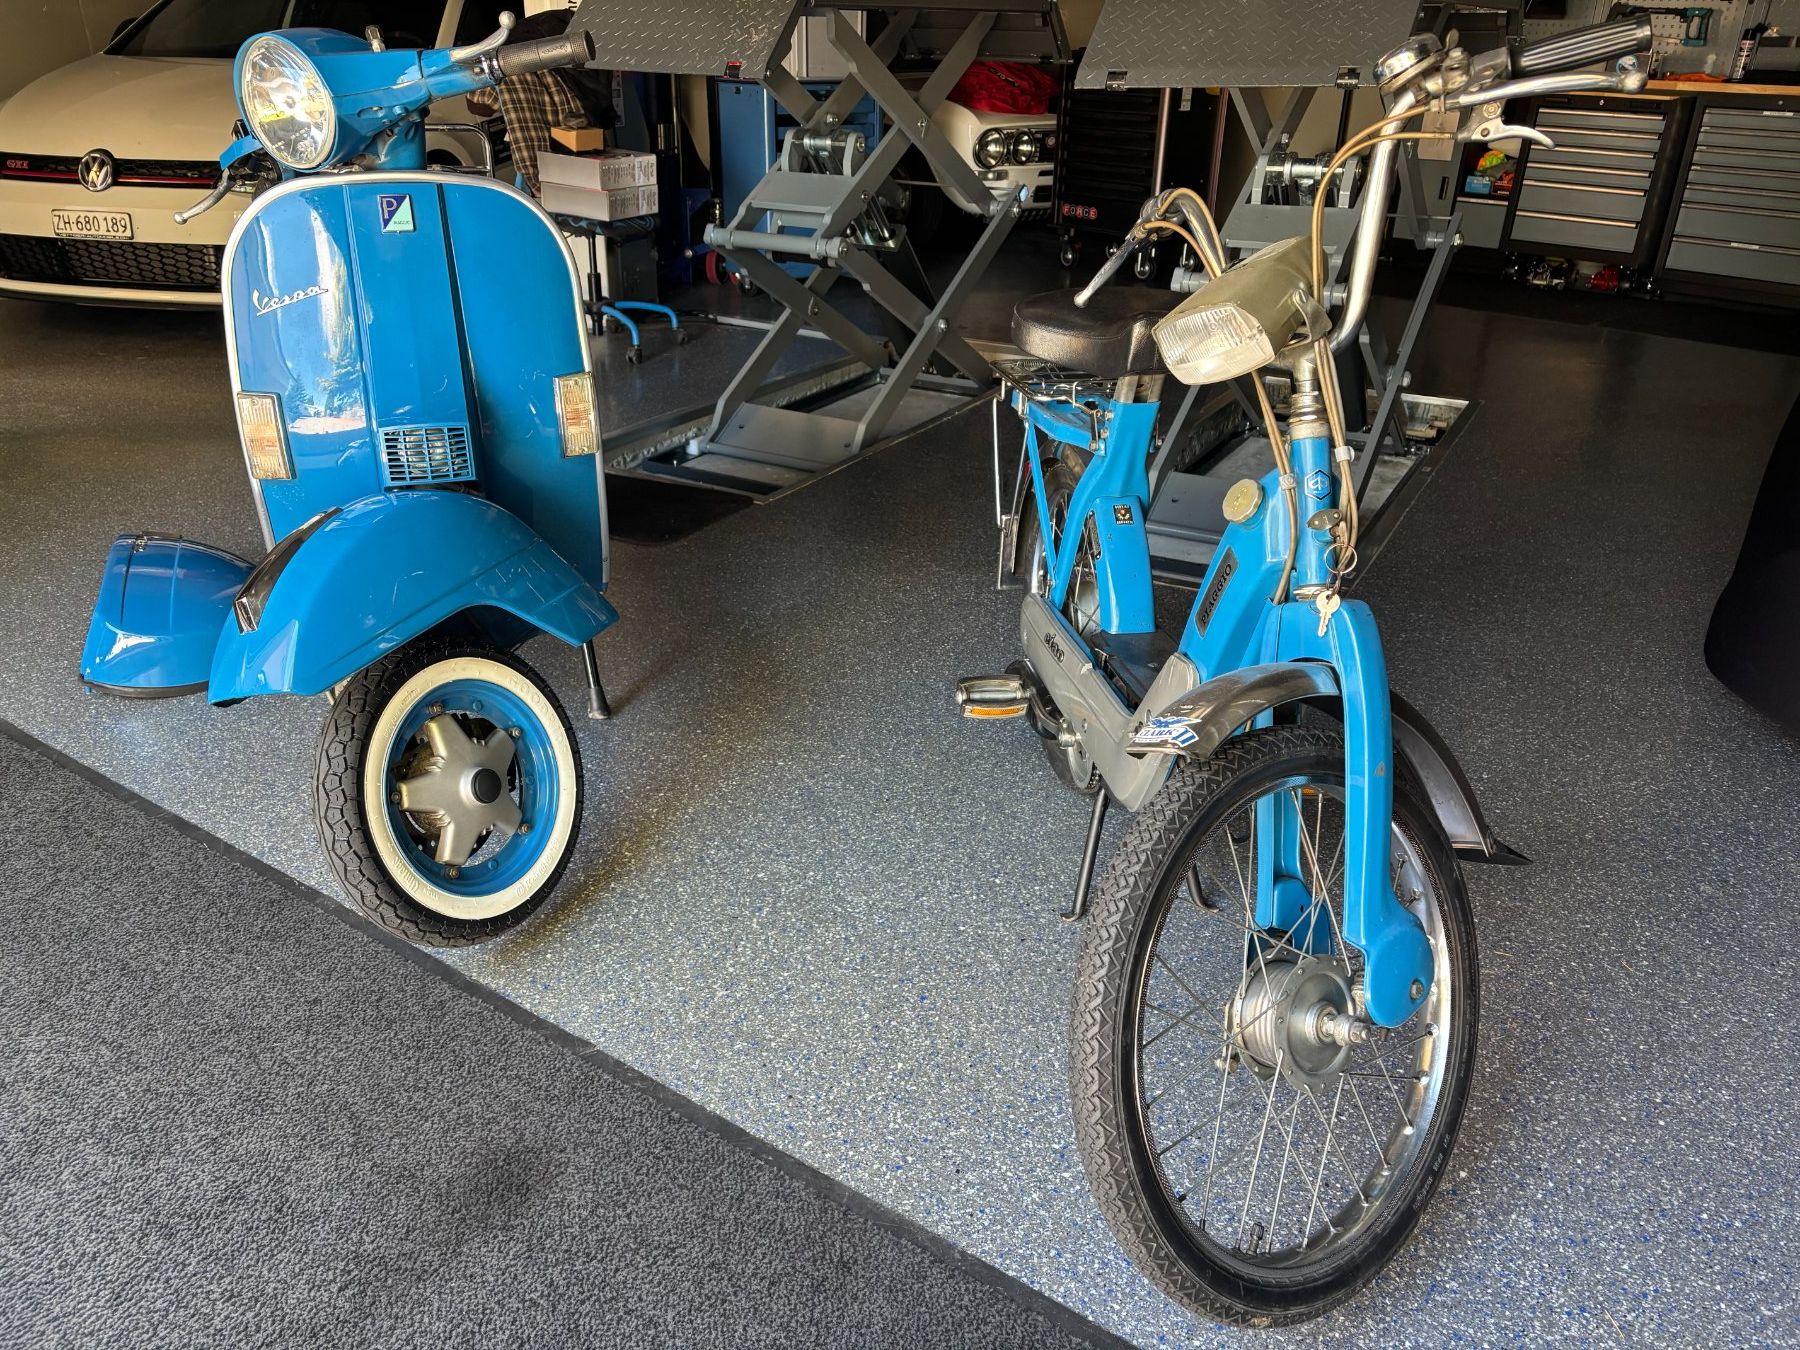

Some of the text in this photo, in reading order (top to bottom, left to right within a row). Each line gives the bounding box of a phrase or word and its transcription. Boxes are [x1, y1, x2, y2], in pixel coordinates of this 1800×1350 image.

[6, 160, 29, 169] GTI
[382, 198, 398, 219] P
[1063, 204, 1098, 220] FORCE
[103, 216, 127, 234] 189
[252, 285, 328, 316] Vespa
[1201, 564, 1231, 625] PIAGGIO
